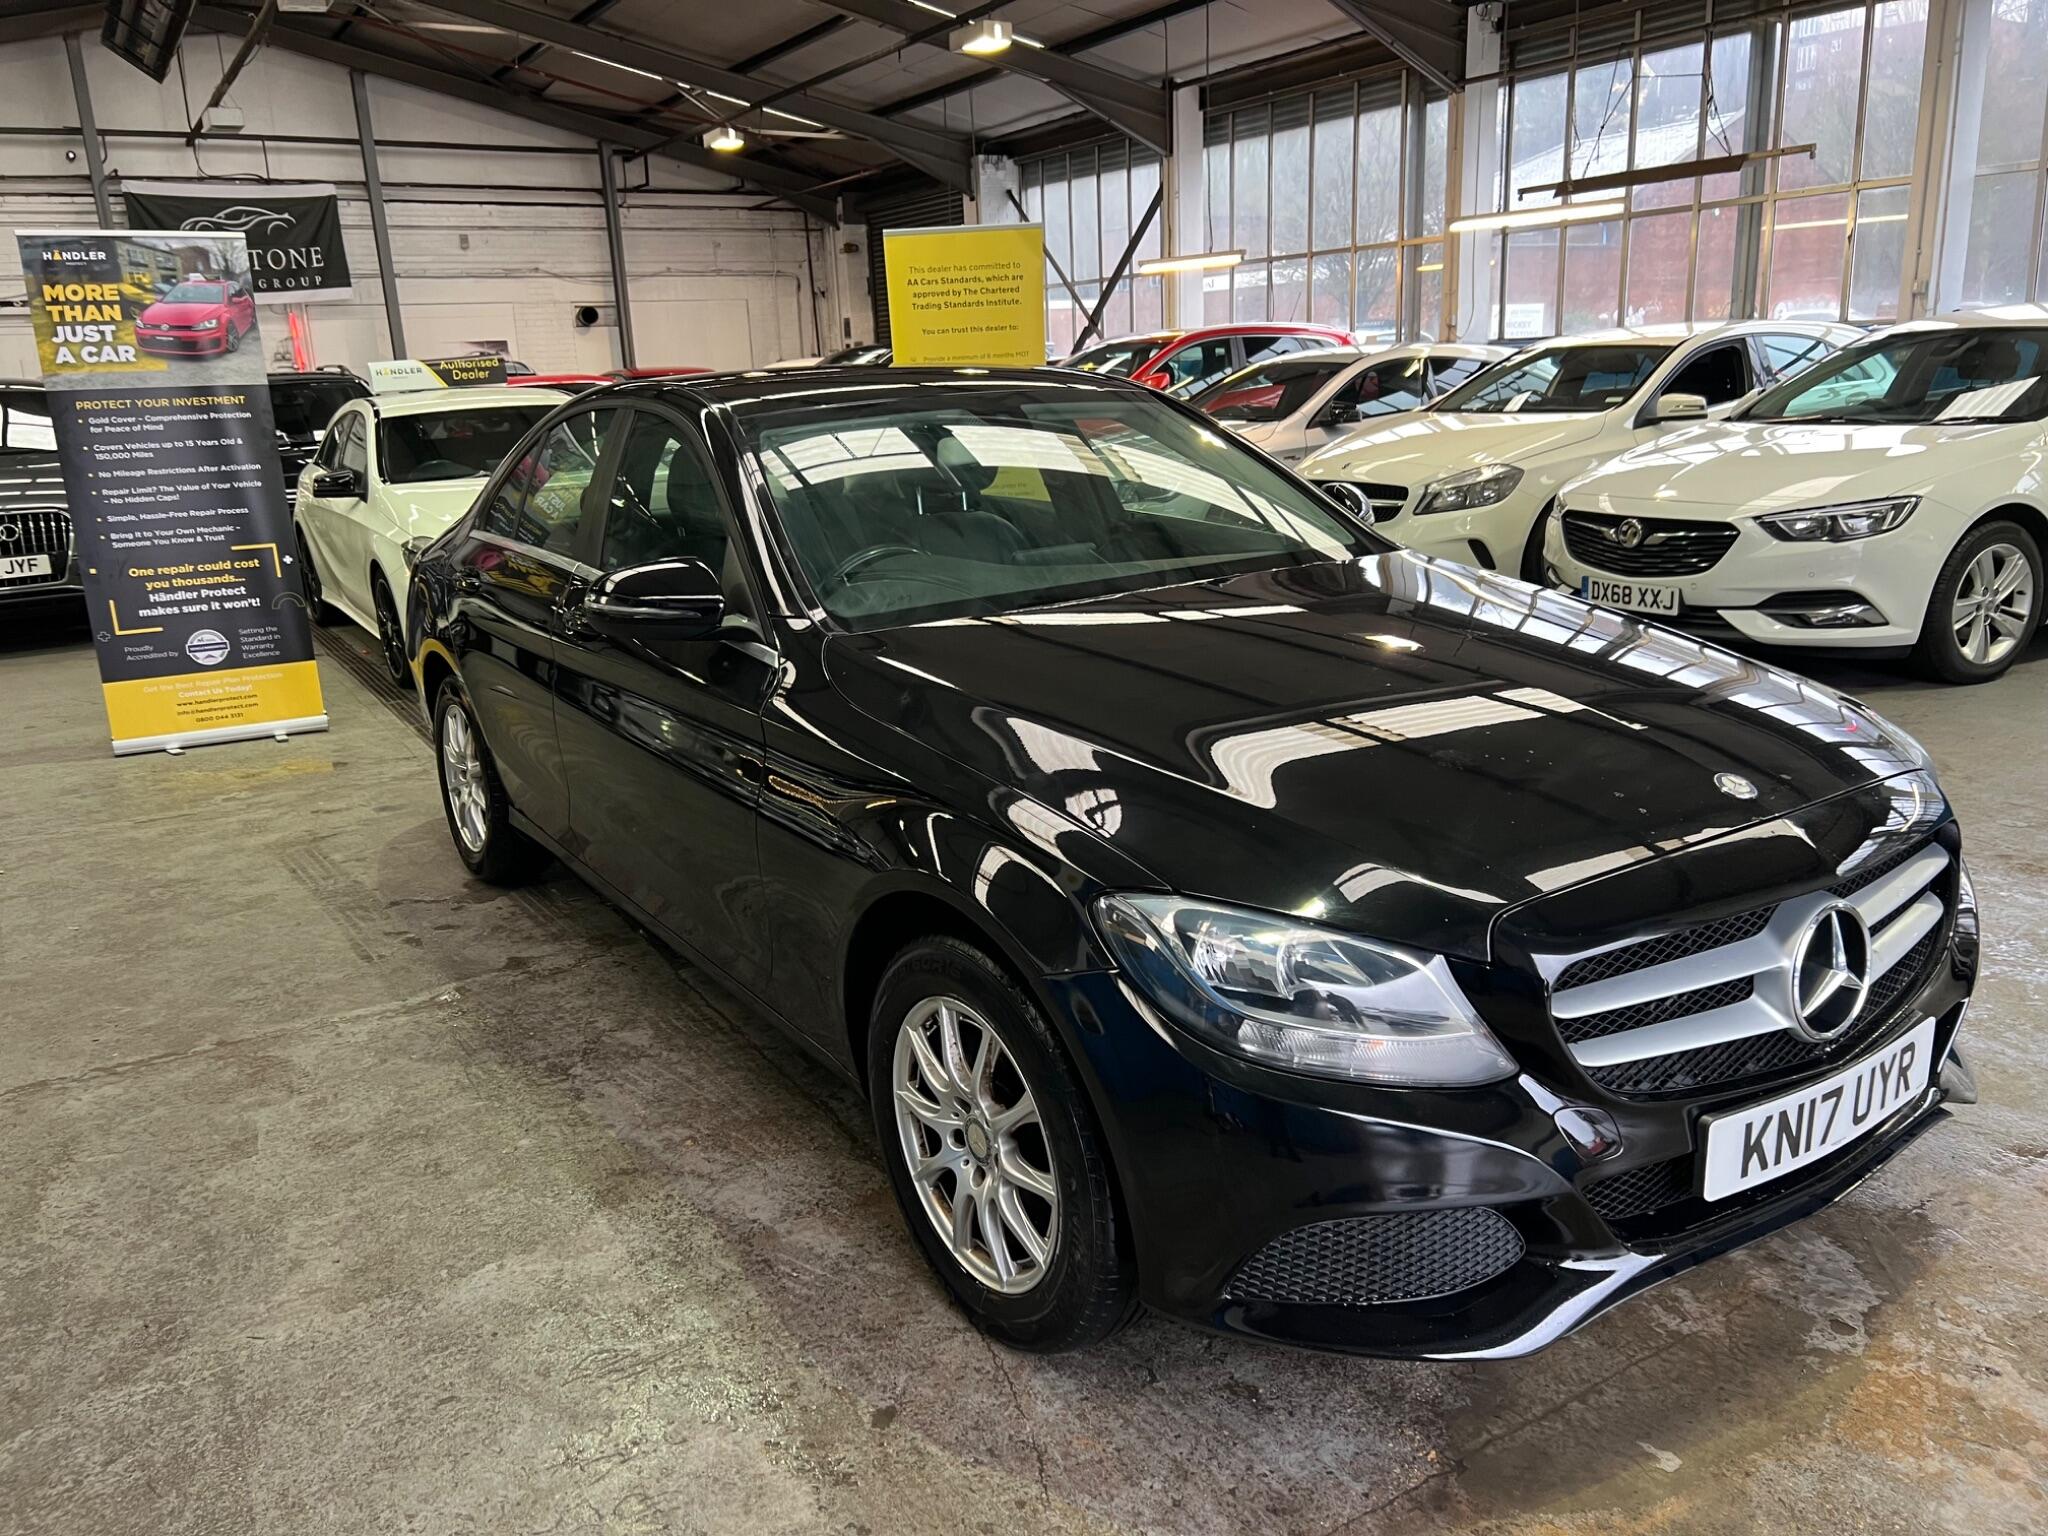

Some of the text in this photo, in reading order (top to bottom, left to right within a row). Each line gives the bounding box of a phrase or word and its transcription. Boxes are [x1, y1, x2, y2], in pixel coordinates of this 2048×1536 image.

[909, 266, 926, 274] This
[927, 265, 952, 274] dealer
[953, 264, 967, 272] has
[968, 262, 1010, 272] committed
[258, 275, 322, 289] GROUP
[907, 278, 919, 286] AA
[920, 277, 939, 286] Cars
[940, 275, 984, 286] Standards,
[986, 274, 1010, 282] which
[42, 284, 120, 301] MORE
[912, 290, 951, 299] approved
[952, 289, 962, 297] by
[979, 286, 1020, 295] Chartered
[911, 298, 1022, 311] Trading Standards Institute.
[45, 304, 122, 322] THAN
[51, 325, 116, 343] JUST
[921, 328, 936, 336] You
[951, 326, 969, 334] trust
[970, 325, 984, 333] this
[55, 345, 137, 363] A CAR
[440, 358, 499, 370] Authorised
[452, 370, 490, 380] Dealer
[75, 395, 246, 411] PROTECT YOUR INVESTMENT
[88, 416, 109, 425] Gold
[111, 416, 136, 424] Cover
[145, 413, 208, 423] Comprehensive
[210, 411, 251, 420] Protection
[105, 425, 130, 433] Peace
[93, 443, 123, 451] Covers
[125, 441, 160, 450] Vehicles
[162, 441, 173, 449] up
[196, 438, 218, 446] Years
[95, 452, 130, 461] 150,000
[113, 470, 146, 478] Mileage
[147, 467, 196, 476] Restrictions
[198, 465, 218, 473] After
[221, 463, 261, 471] Activation
[102, 488, 129, 496] Repair
[131, 486, 157, 494] Limit?
[176, 483, 199, 491] Value
[232, 480, 262, 488] Vehicle
[125, 495, 155, 503] Hidden
[156, 494, 180, 502] Caps!
[106, 507, 249, 523] Simple, Hassle-Free Repair Process
[110, 531, 133, 540] Bring
[154, 529, 174, 537] Your
[197, 525, 234, 533] Mechanic
[112, 540, 151, 549] Someone
[171, 536, 194, 544] Know
[5, 558, 37, 574] JYF
[128, 558, 260, 577] One repair could cost
[145, 580, 169, 590] you
[148, 586, 246, 603] Händler Protect
[1591, 581, 1674, 610] DX68 XXJ
[138, 597, 260, 617] makes sure it won't!
[238, 625, 278, 636] Setting the
[239, 634, 272, 643] Standard
[124, 645, 154, 654] Proudly
[241, 642, 275, 651] Warranty
[126, 652, 166, 661] Accredited
[242, 650, 280, 659] Excellence
[178, 690, 211, 698] Contact
[225, 684, 253, 693] Today!
[1740, 1041, 1916, 1180] KN17 UYR
